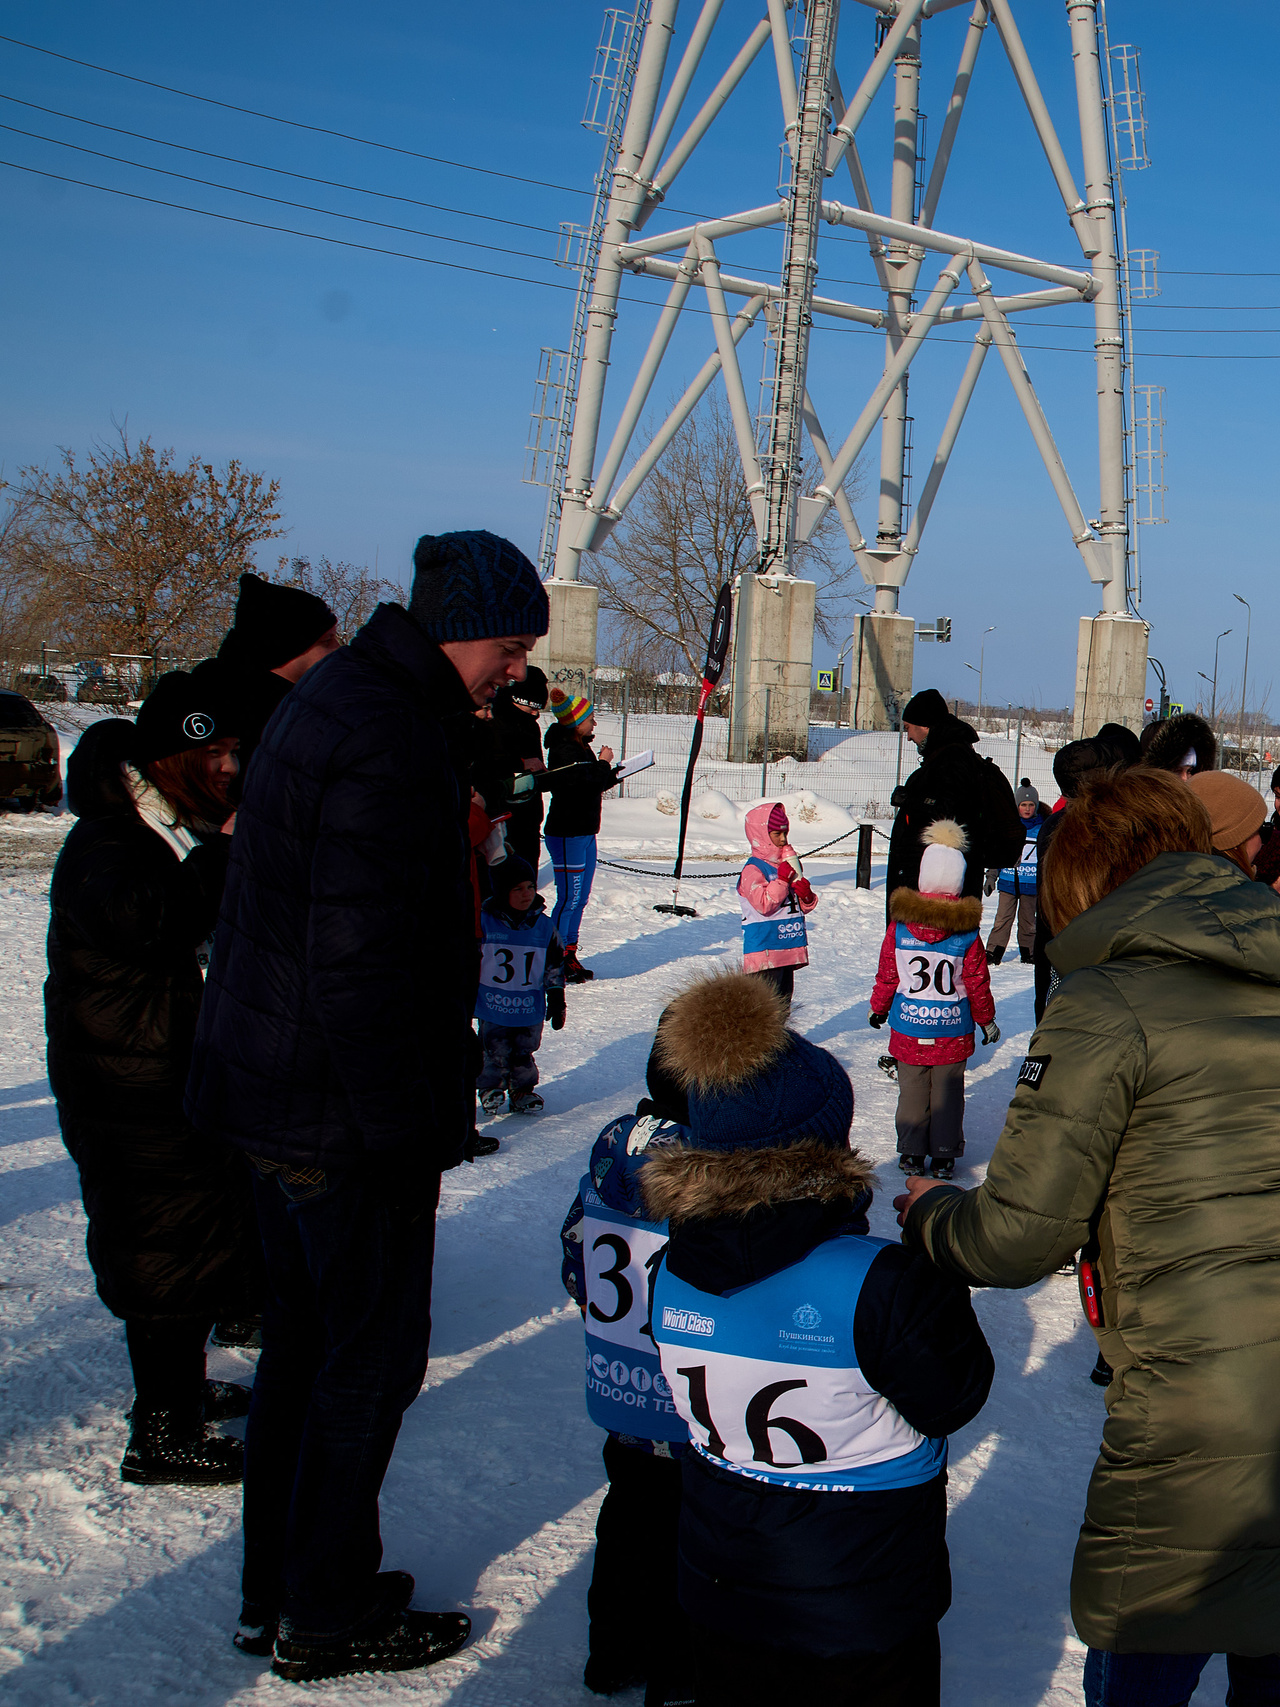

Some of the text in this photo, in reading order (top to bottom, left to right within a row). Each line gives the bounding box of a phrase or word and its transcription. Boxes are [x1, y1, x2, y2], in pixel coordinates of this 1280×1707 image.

[778, 931, 804, 940] OUTDOO
[492, 948, 536, 987] 31
[908, 955, 957, 996] 30
[899, 1014, 962, 1026] OUTDOOR TEAM
[664, 1308, 713, 1335] World Class
[778, 1329, 835, 1344] Пушкинский
[677, 1365, 827, 1468] 16
